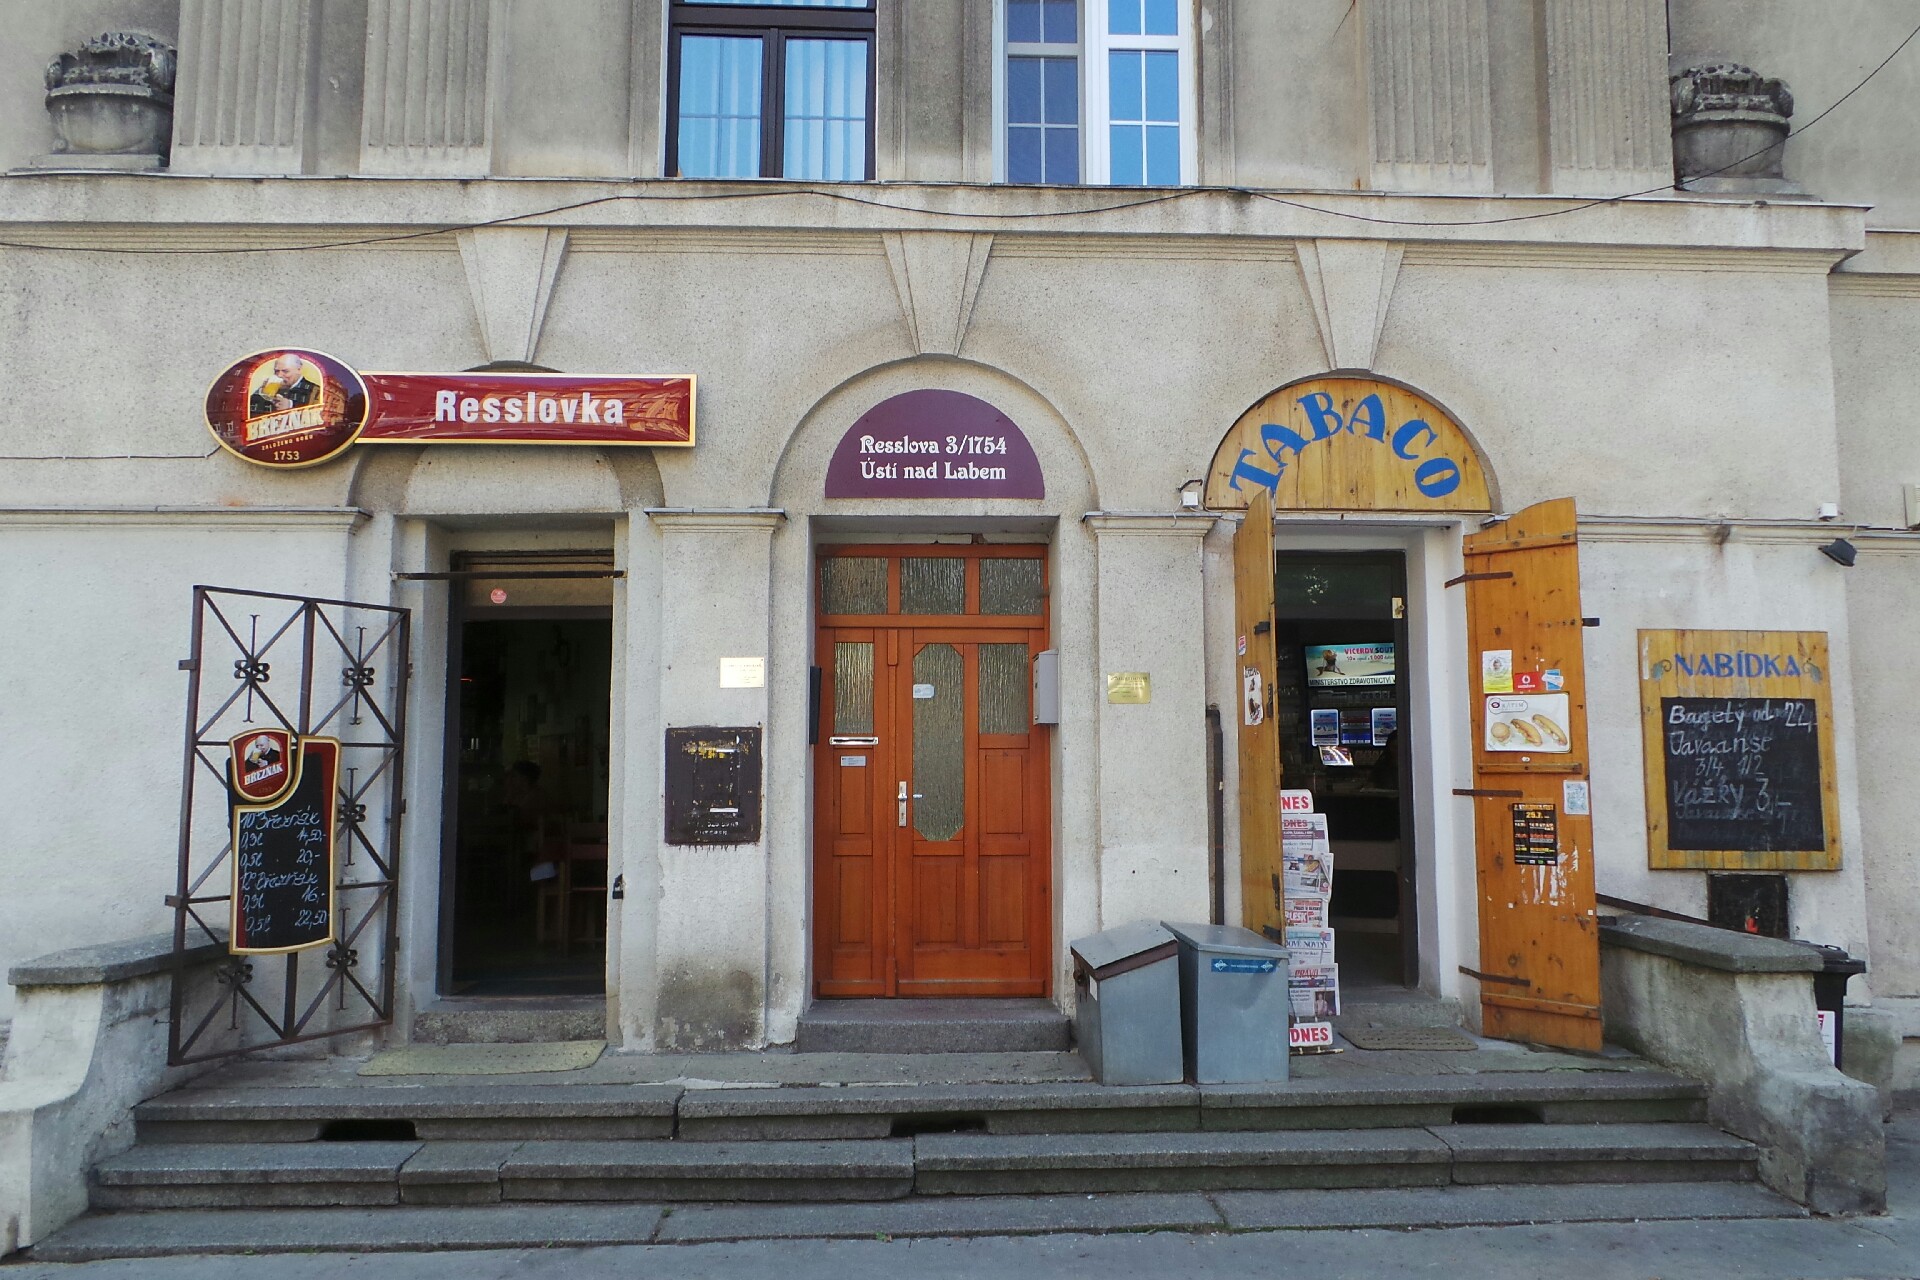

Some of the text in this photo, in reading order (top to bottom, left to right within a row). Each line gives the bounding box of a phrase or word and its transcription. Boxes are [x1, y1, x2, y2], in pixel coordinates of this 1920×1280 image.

[435, 389, 624, 424] Resslovka
[859, 435, 1007, 455] Resslova 3/1754
[1229, 391, 1461, 498] TABACO
[273, 450, 300, 461] 1753
[860, 457, 1007, 480] Ústí nad Labem
[1674, 650, 1803, 678] NABÍDKA
[1309, 678, 1348, 686] MINISTERSTVO
[1349, 676, 1392, 685] ZDRAVOTNICTVÍ
[1281, 796, 1309, 810] NES
[1283, 819, 1308, 828] DNES
[1289, 1026, 1329, 1043] DNES
